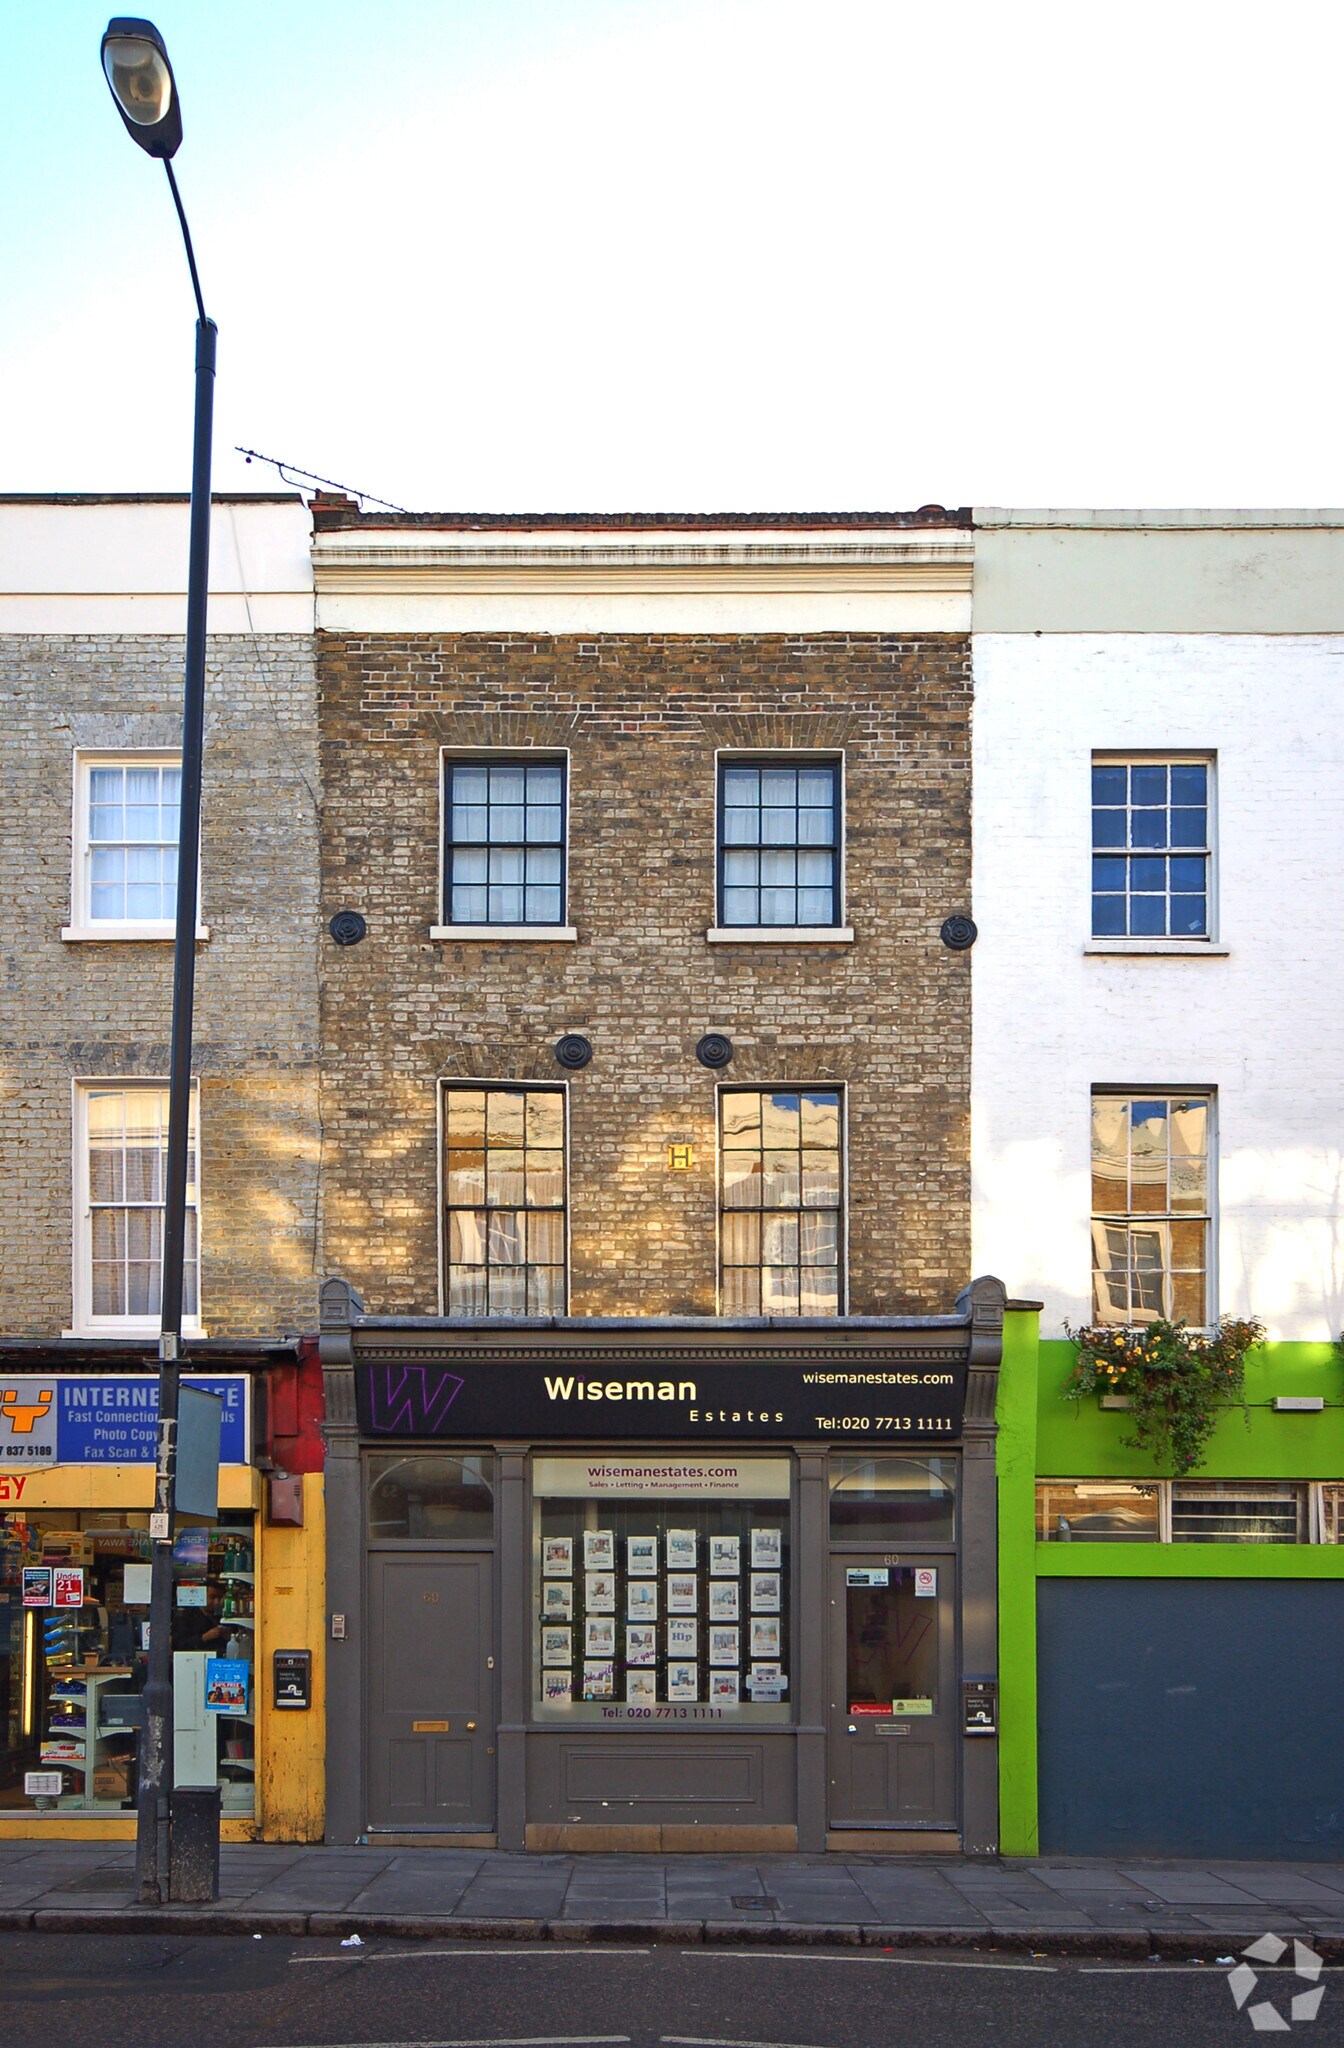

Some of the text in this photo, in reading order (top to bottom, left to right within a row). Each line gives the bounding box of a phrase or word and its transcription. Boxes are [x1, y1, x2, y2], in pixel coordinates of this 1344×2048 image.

[671, 1147, 689, 1167] H
[803, 1371, 954, 1384] wisemanestates.com
[544, 1375, 697, 1401] Wiseman
[64, 1387, 159, 1407] INTERNE
[68, 1411, 92, 1423] Fast
[689, 1410, 784, 1422] Estates
[815, 1417, 952, 1430] Tel:020 7713 1111
[94, 1428, 127, 1440] Photo
[6, 1446, 25, 1456] 837
[27, 1445, 52, 1456] 5189
[84, 1446, 105, 1458] Fax
[108, 1446, 137, 1458] Scan
[141, 1446, 149, 1458] &
[588, 1465, 738, 1478] wisemanestates.com
[615, 1481, 644, 1490] Letting
[650, 1481, 703, 1490] Management
[709, 1481, 739, 1489] Finance
[884, 1554, 899, 1566] 60
[56, 1572, 81, 1581] Under
[57, 1580, 73, 1591] 21
[423, 1591, 439, 1603] 60
[669, 1619, 695, 1629] Free
[671, 1631, 693, 1643] Hip
[601, 1707, 722, 1718] Tel: 020 7713 1111
